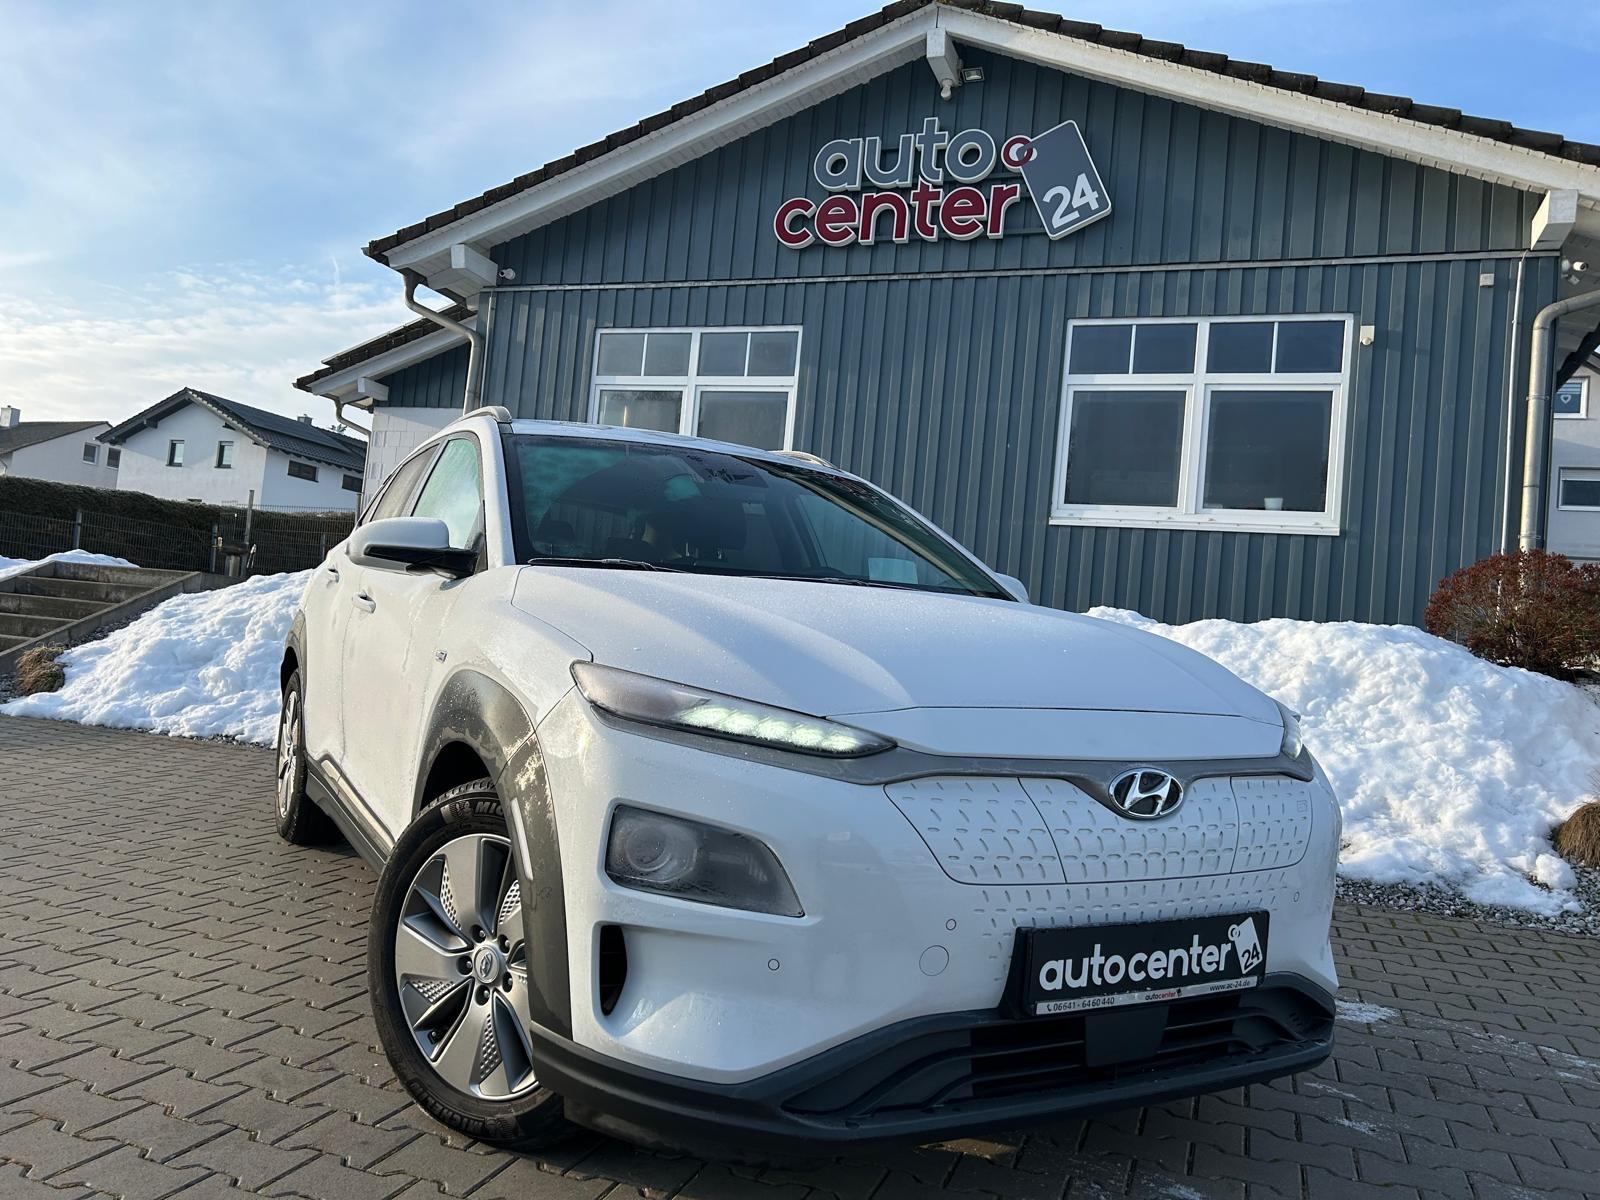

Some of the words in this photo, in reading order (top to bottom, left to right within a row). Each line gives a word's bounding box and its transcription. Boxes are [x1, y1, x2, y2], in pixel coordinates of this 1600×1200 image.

[813, 116, 997, 192] auto
[774, 178, 1021, 249] center
[1042, 172, 1099, 230] 24
[1038, 934, 1232, 991] autocenter
[1241, 942, 1260, 970] 24
